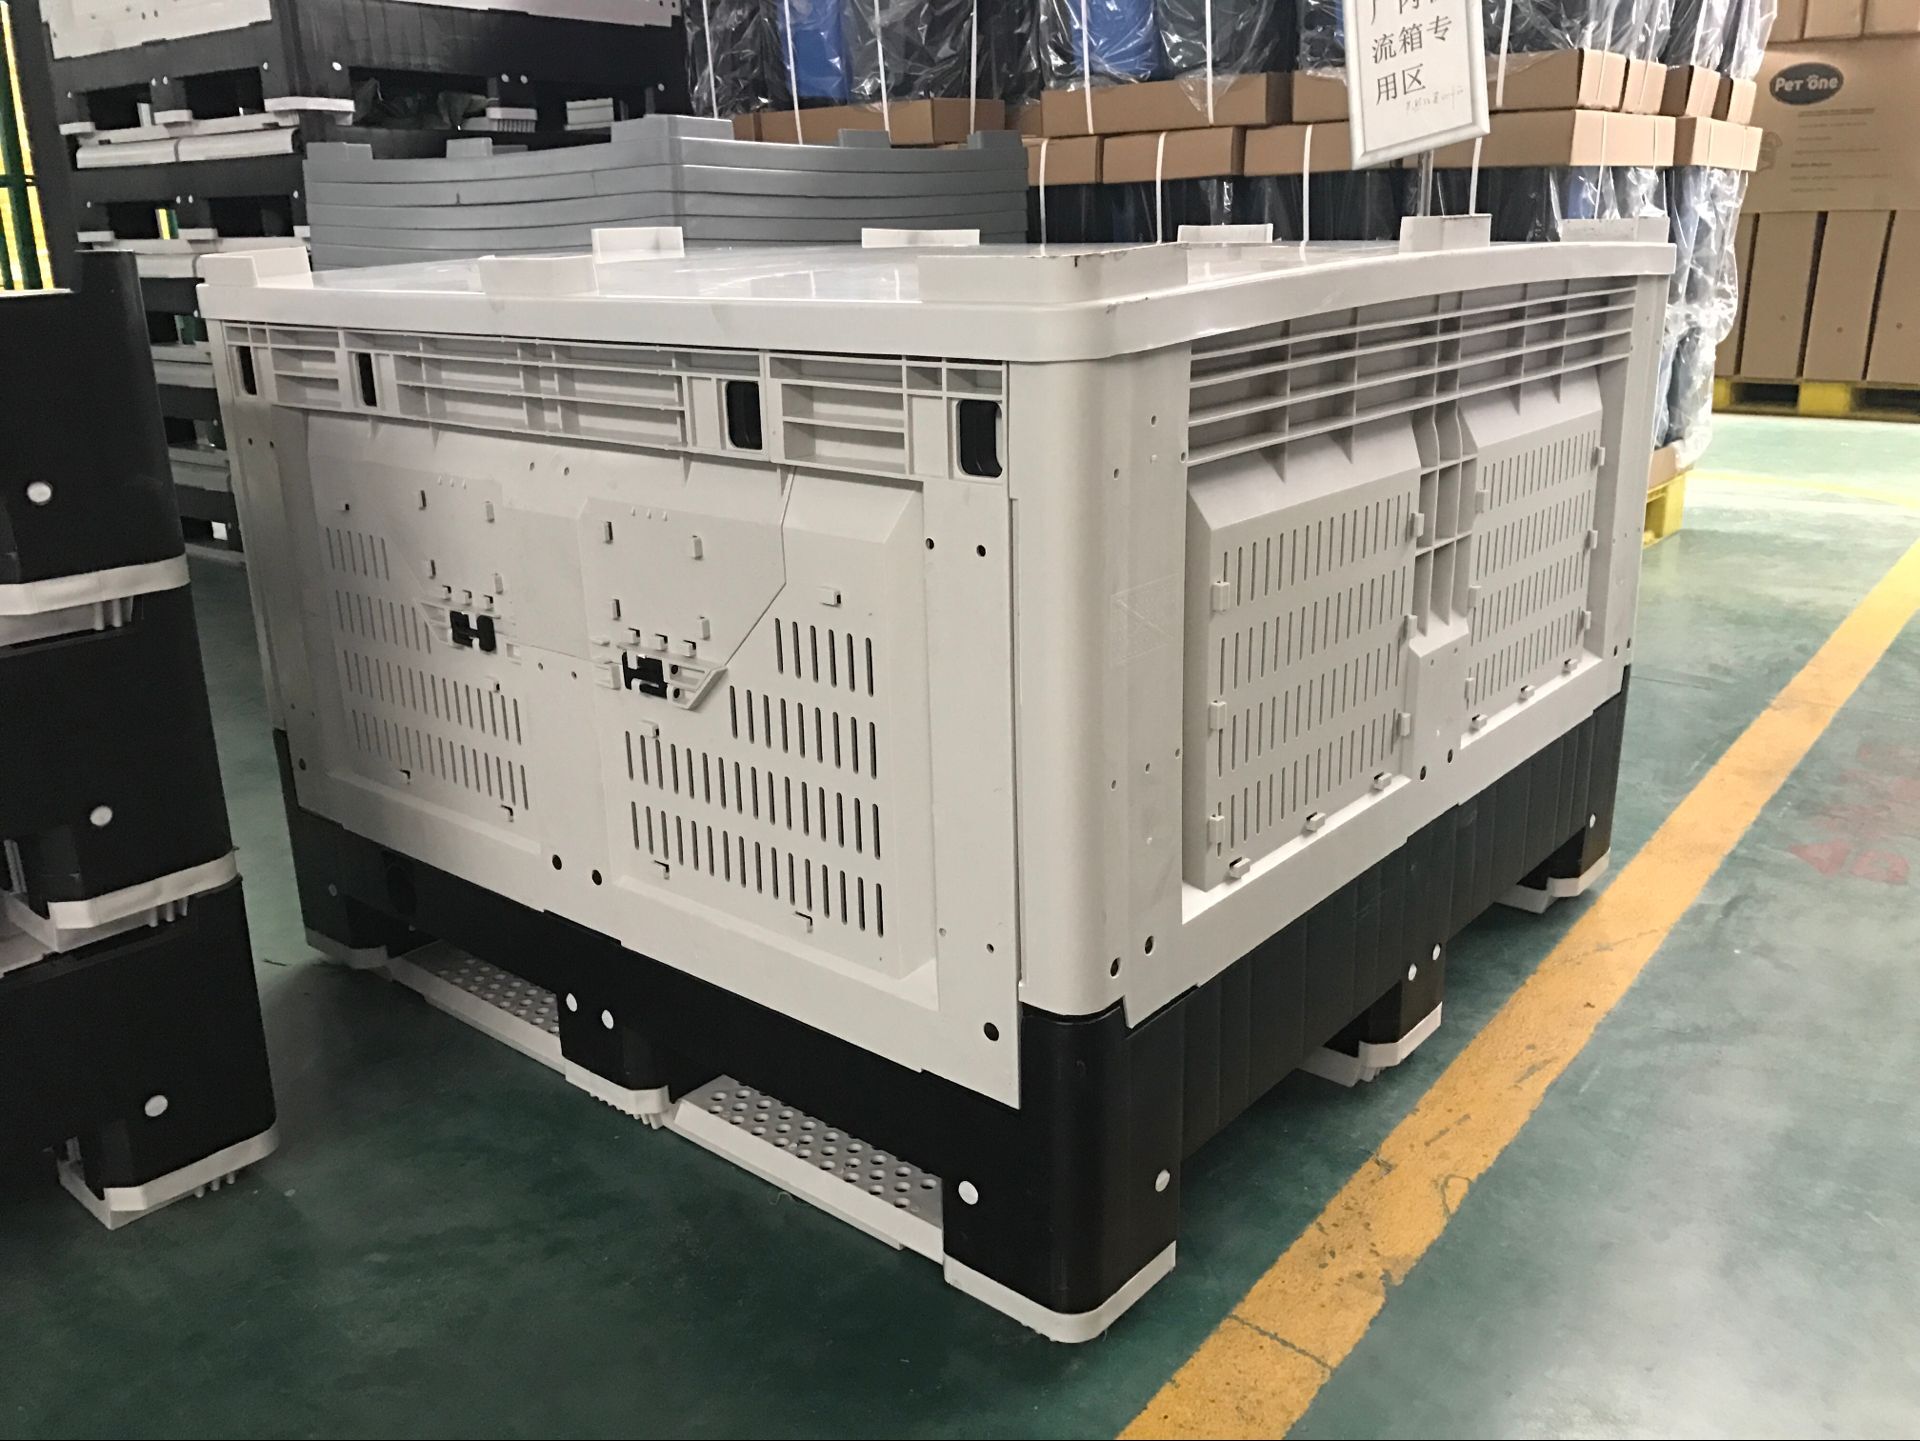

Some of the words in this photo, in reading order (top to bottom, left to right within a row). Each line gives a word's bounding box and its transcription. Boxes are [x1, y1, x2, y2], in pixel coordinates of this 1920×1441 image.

[1372, 15, 1452, 64] 流箱专
[1376, 63, 1426, 105] 用区
